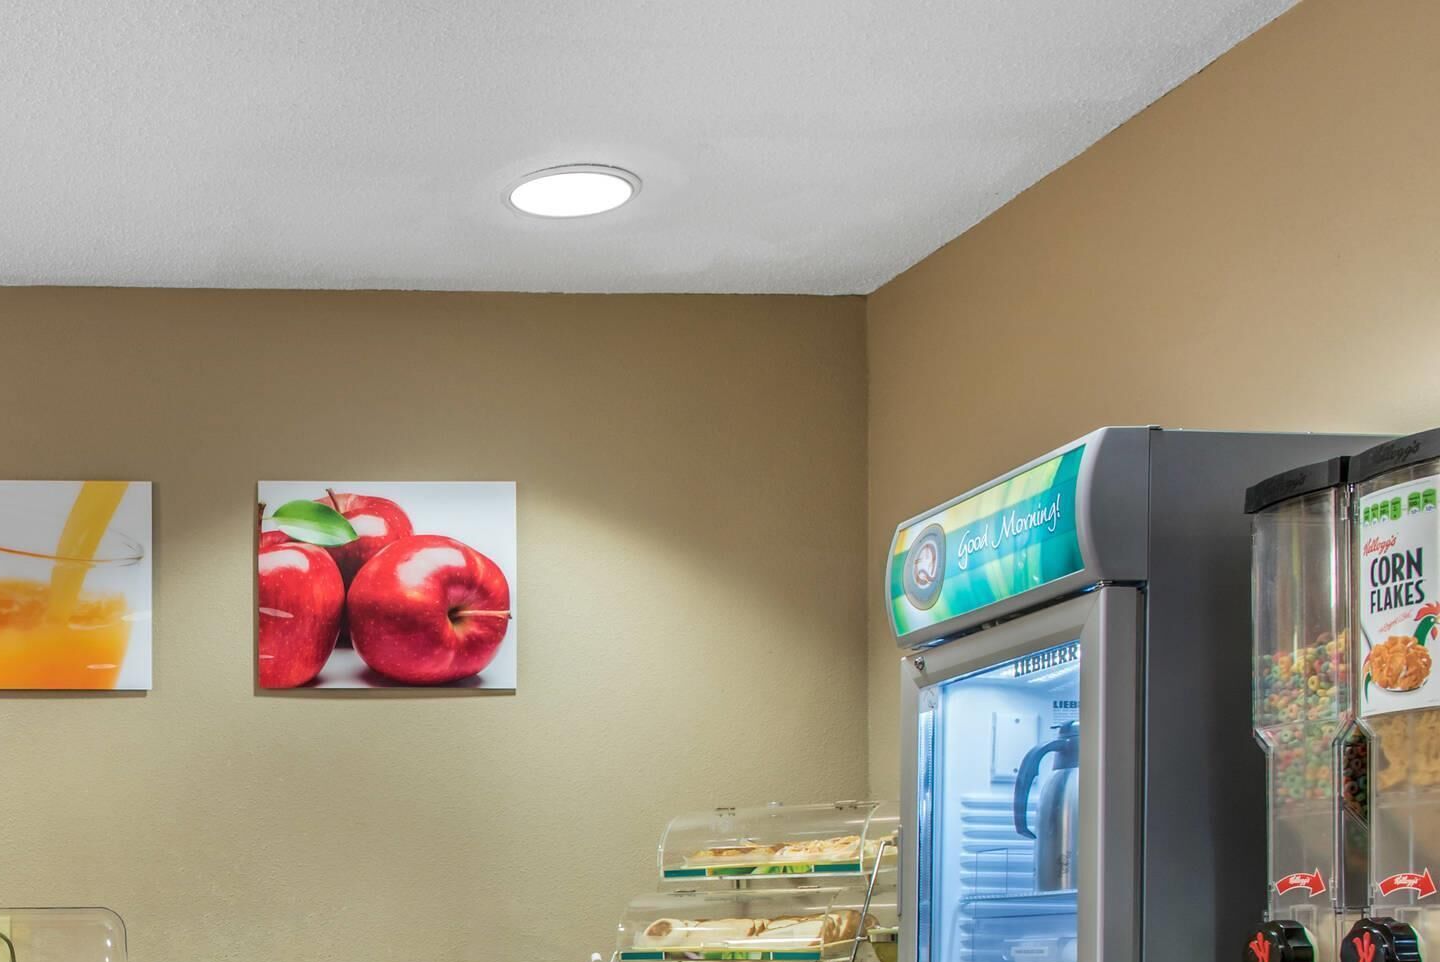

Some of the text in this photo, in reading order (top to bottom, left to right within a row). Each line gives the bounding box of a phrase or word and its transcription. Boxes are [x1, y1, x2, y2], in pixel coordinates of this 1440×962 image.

[957, 493, 1061, 570] Good Morning!
[1370, 547, 1423, 588] CORN
[1370, 580, 1425, 614] FLAKES
[1014, 644, 1078, 678] LIEBHERR
